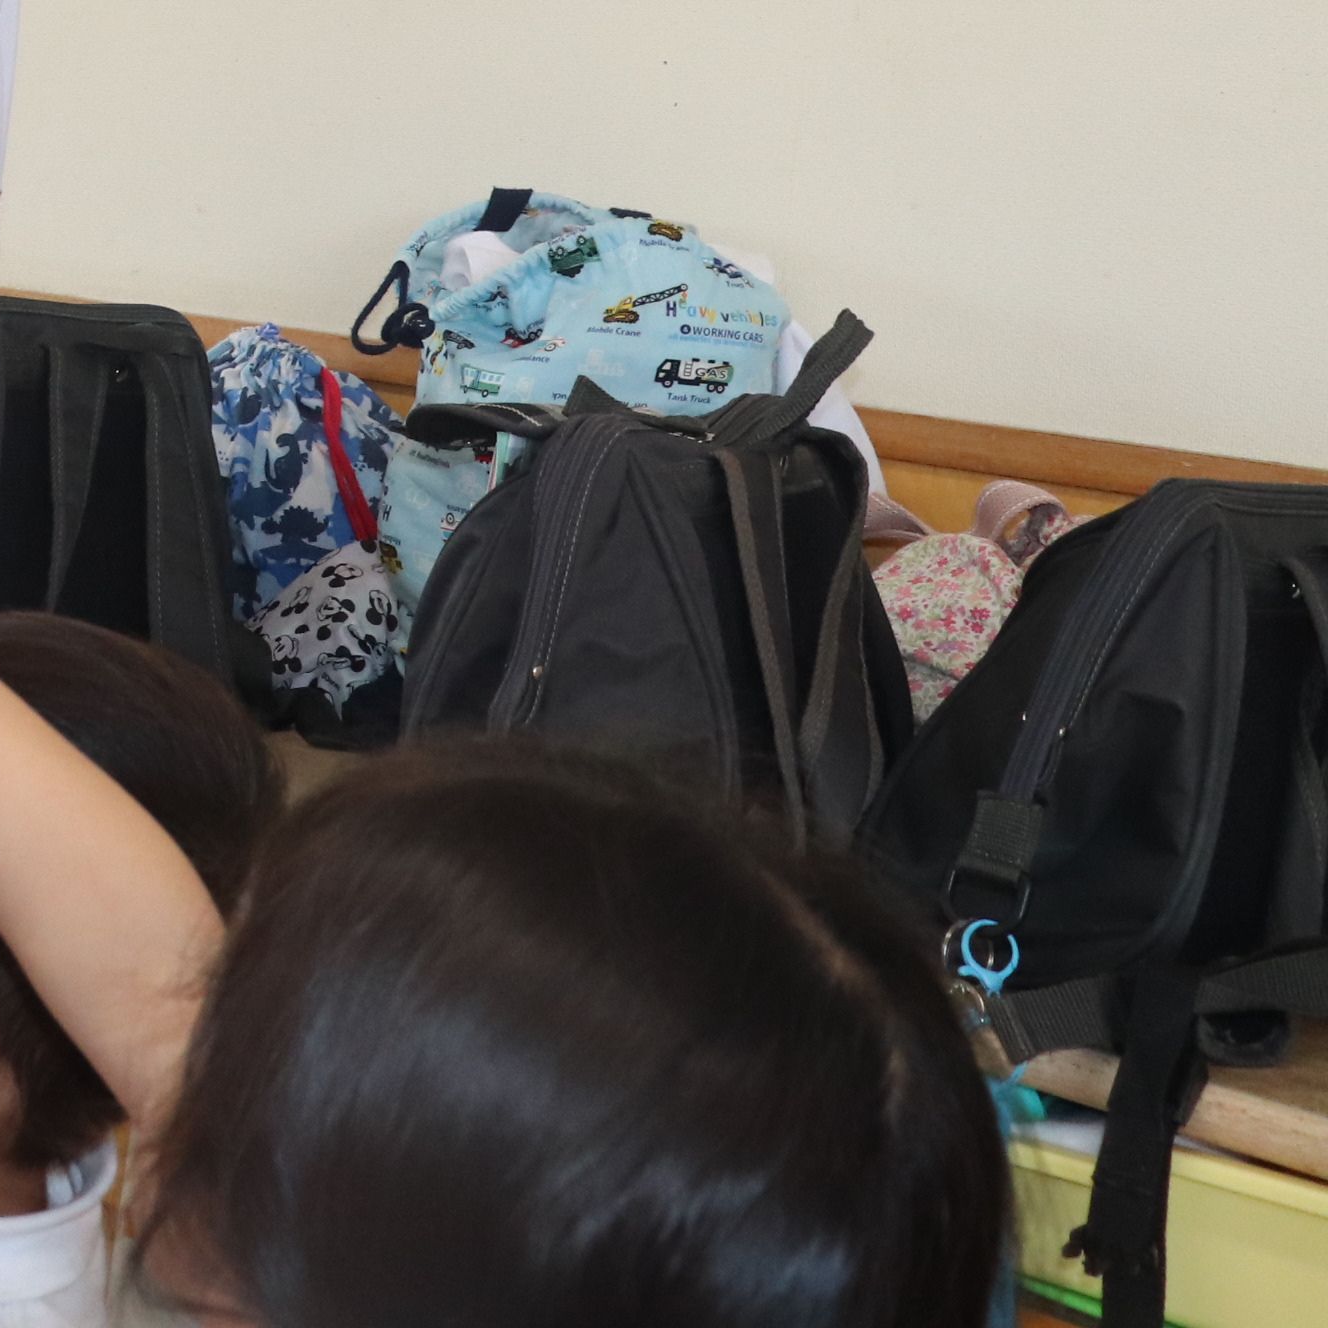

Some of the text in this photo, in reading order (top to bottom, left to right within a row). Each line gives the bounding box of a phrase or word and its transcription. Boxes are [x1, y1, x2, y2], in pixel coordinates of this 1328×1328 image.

[666, 298, 717, 324] Heavy
[615, 327, 641, 336] Crane
[693, 326, 741, 341] WORKING
[743, 331, 764, 343] CARS
[695, 367, 727, 379] GAS
[667, 392, 711, 404] Tank Truck
